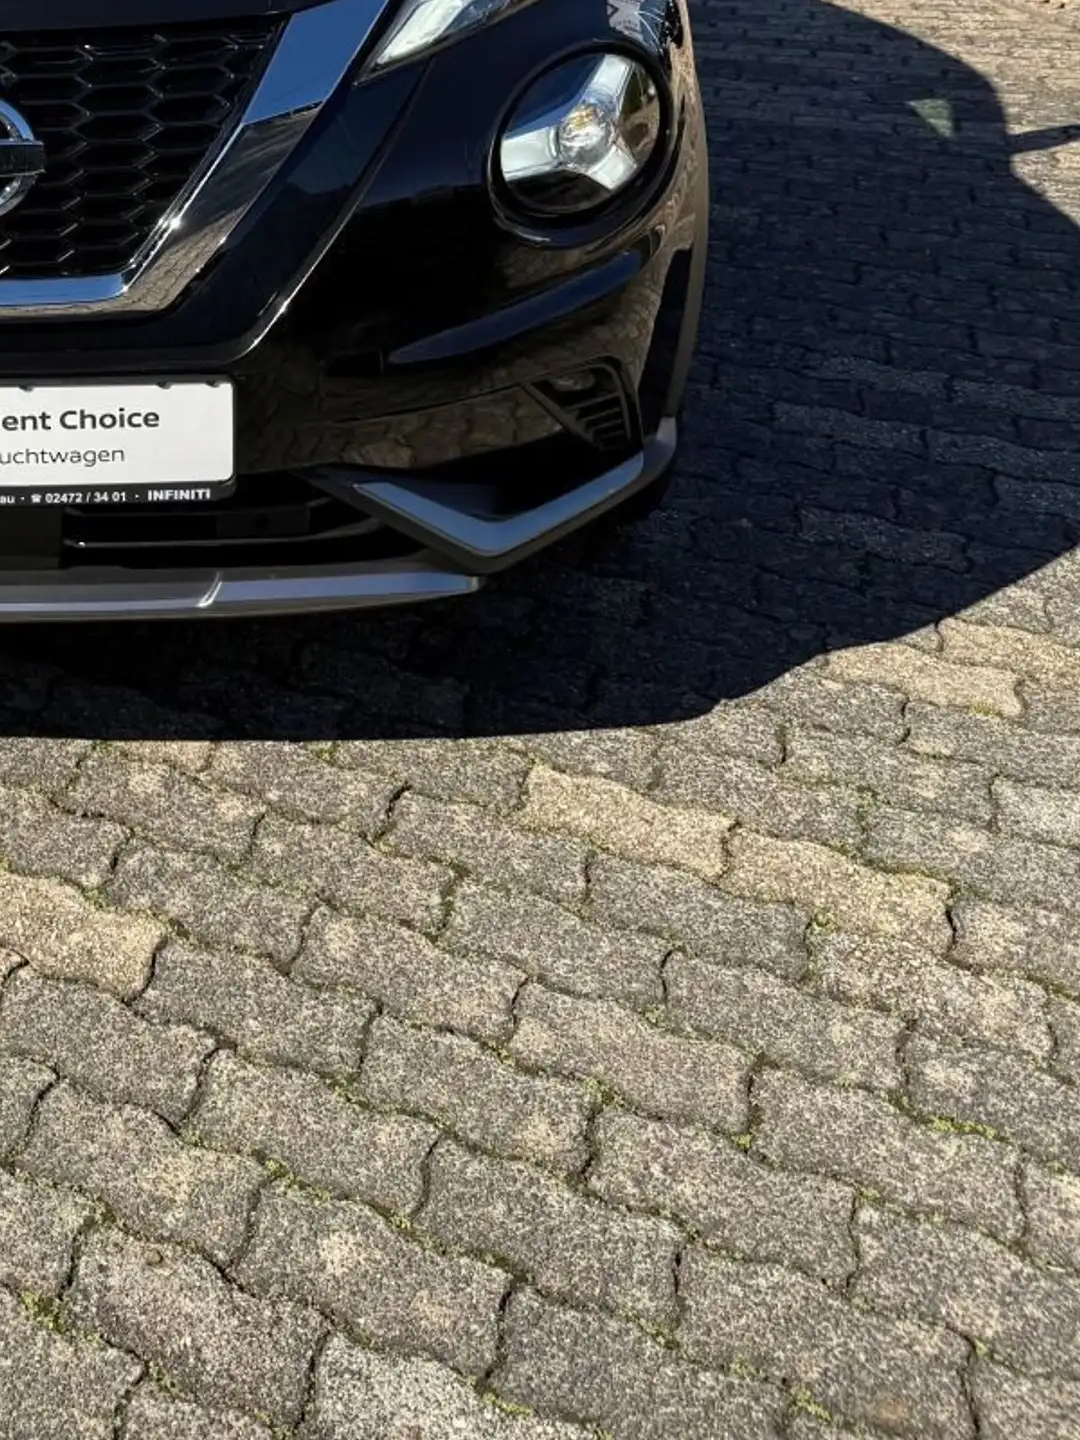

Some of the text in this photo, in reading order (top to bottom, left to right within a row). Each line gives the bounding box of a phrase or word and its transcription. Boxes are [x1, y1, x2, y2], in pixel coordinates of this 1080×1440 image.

[59, 407, 160, 430] Choice
[45, 490, 83, 504] 02472
[93, 490, 109, 503] 34
[111, 490, 127, 502] 01
[147, 488, 211, 502] INFINITI
